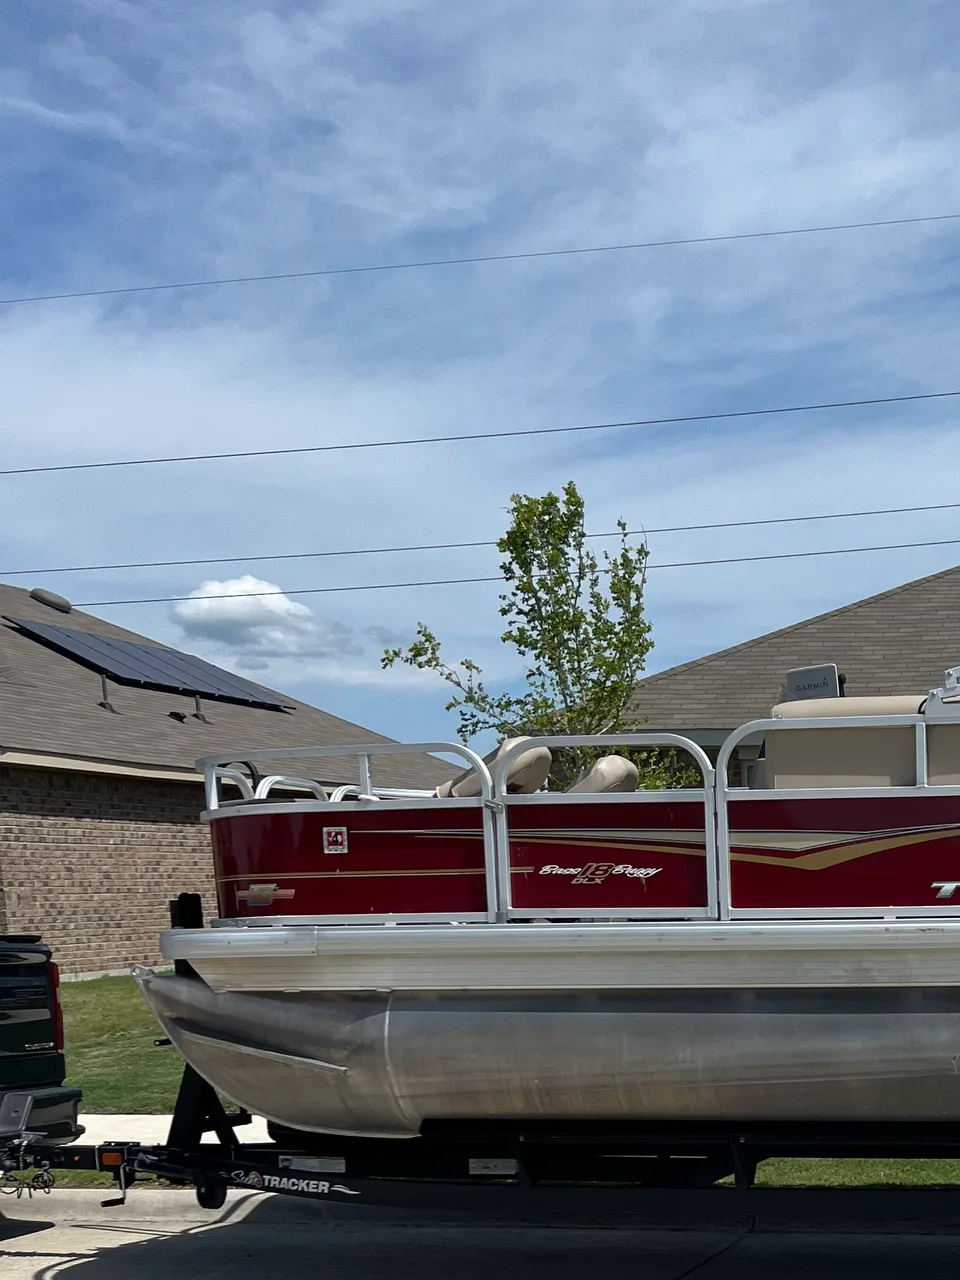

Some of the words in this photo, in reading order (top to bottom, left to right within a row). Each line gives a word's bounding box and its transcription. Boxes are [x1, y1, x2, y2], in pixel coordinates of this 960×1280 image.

[796, 681, 829, 692] GARMIN
[539, 864, 582, 874] Bass
[577, 862, 616, 877] 18
[262, 1175, 330, 1193] TRACKER
